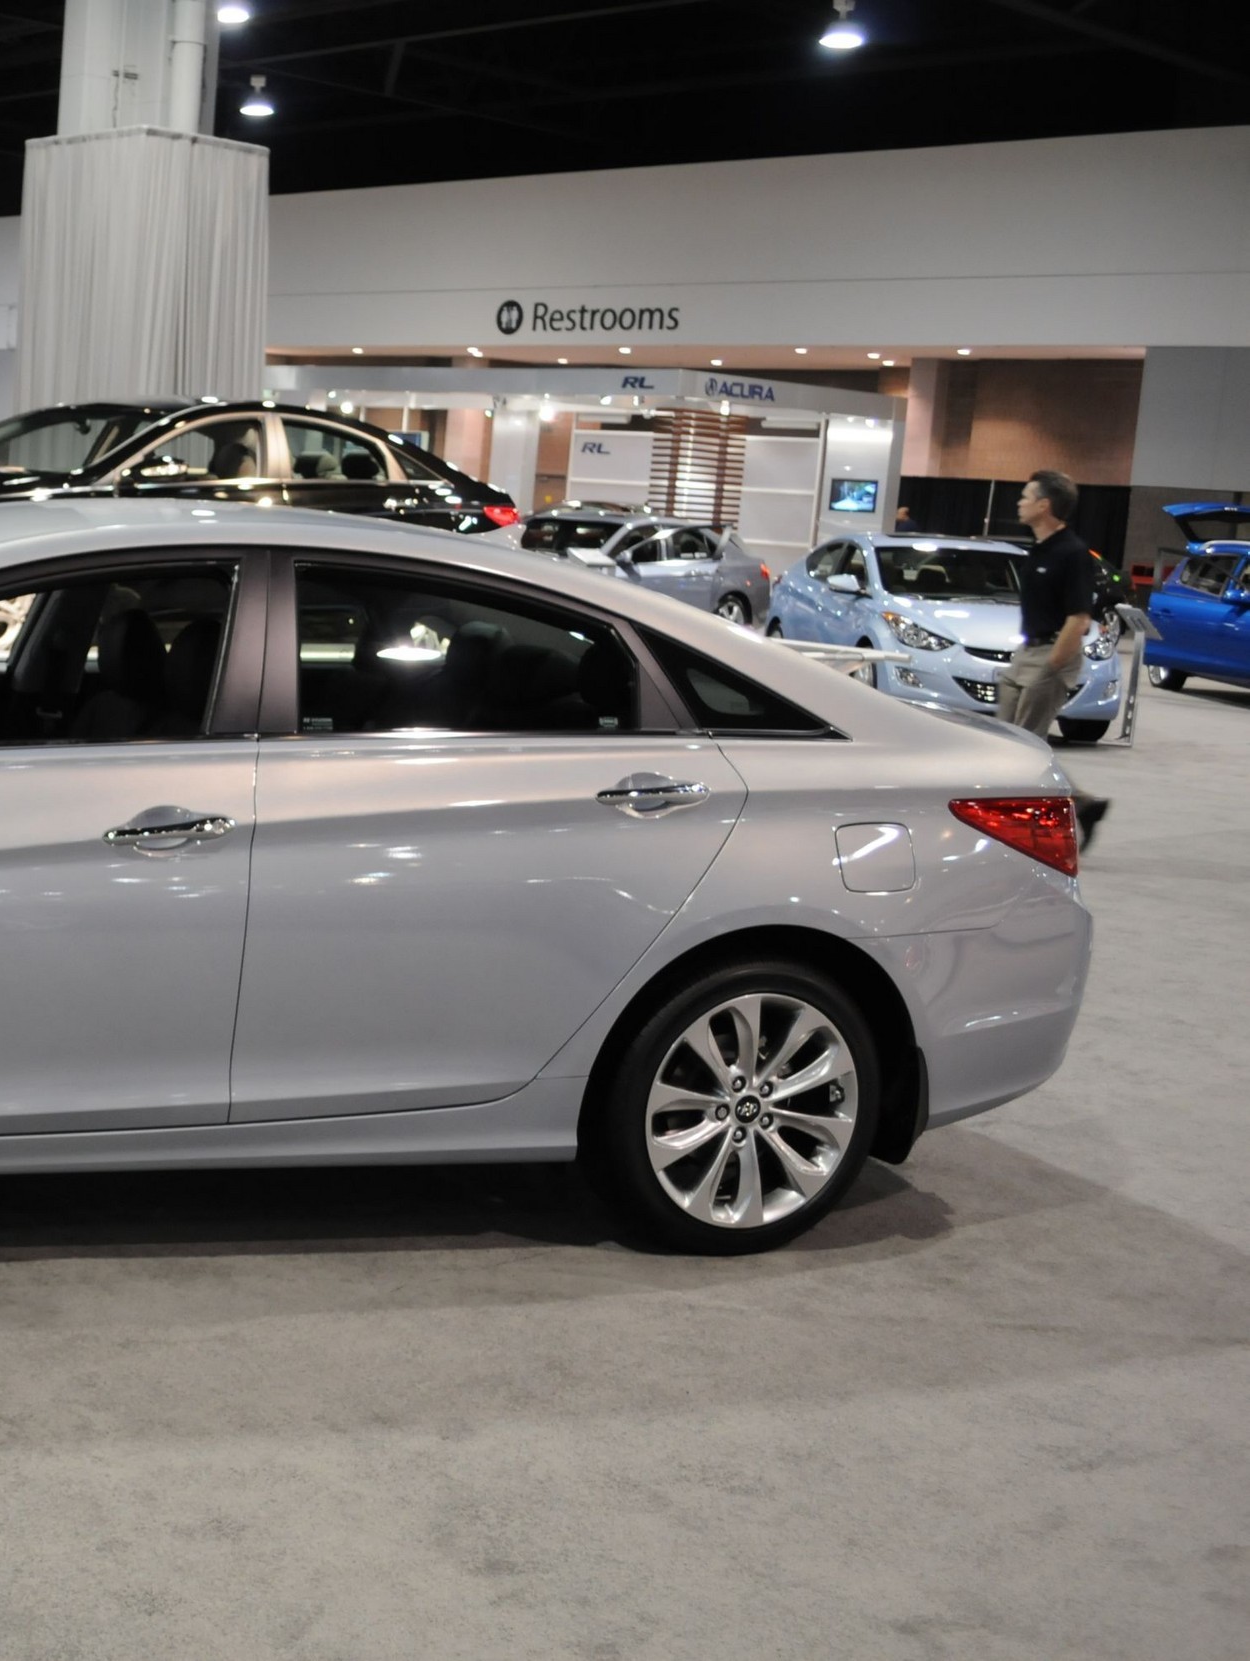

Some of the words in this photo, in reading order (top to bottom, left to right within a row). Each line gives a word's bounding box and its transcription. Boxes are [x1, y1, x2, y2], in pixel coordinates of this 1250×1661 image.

[532, 302, 680, 331] Restrooms
[621, 376, 654, 389] RL
[718, 383, 775, 402] ACURA
[581, 442, 610, 454] RL
